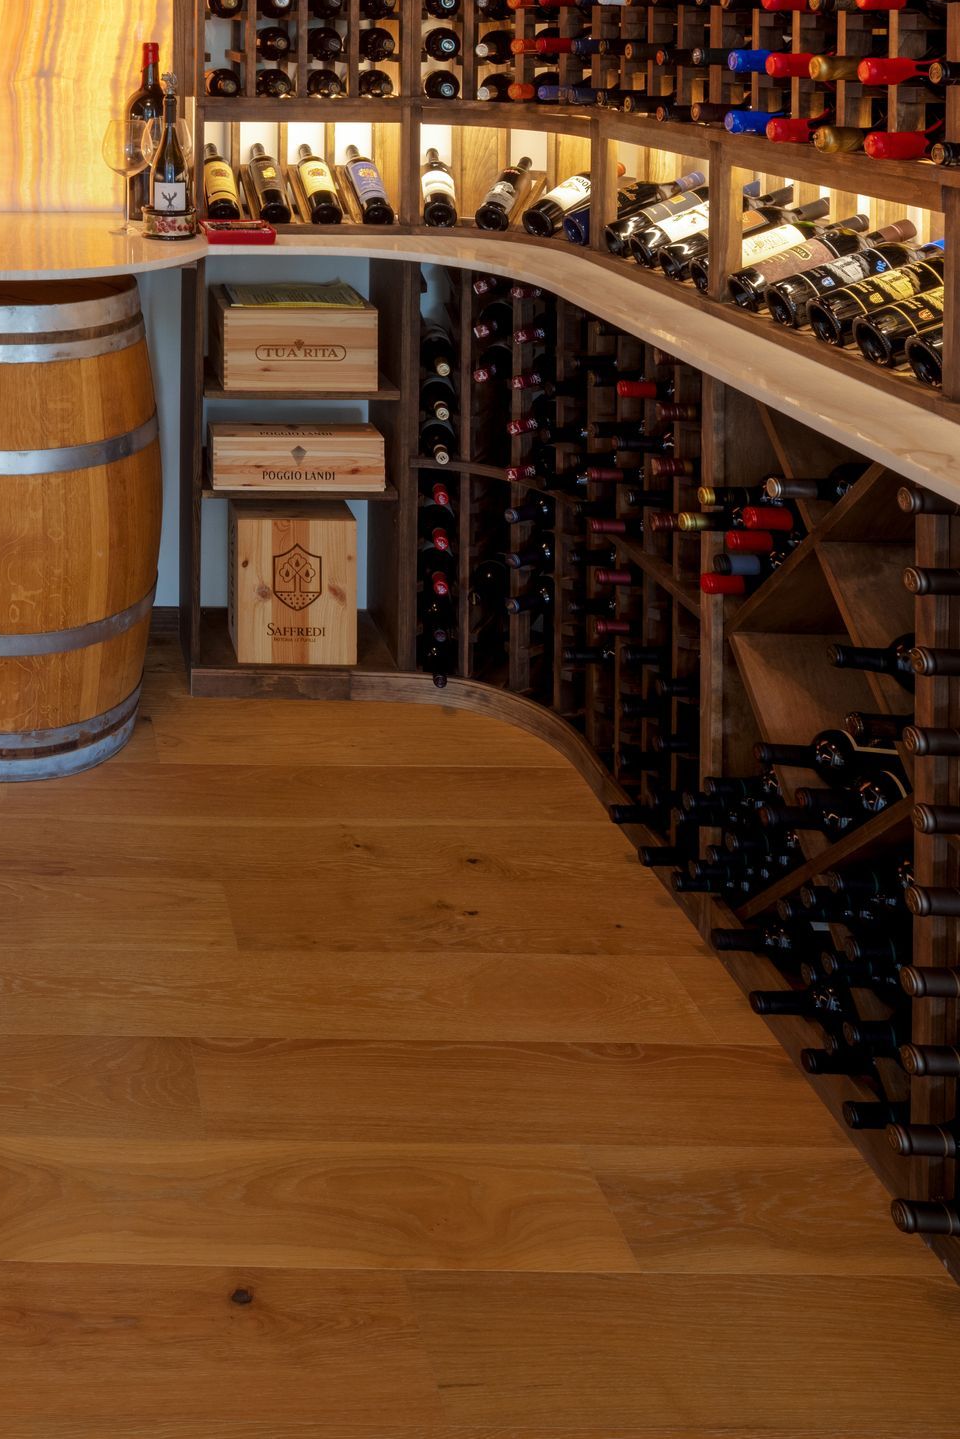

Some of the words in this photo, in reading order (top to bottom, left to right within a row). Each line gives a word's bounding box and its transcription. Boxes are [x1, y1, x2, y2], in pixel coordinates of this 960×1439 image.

[262, 347, 298, 358] TUA
[303, 347, 339, 358] RITA
[262, 470, 302, 481] POGGIO
[304, 470, 336, 481] LANDI
[266, 622, 326, 637] SAFFREDI
